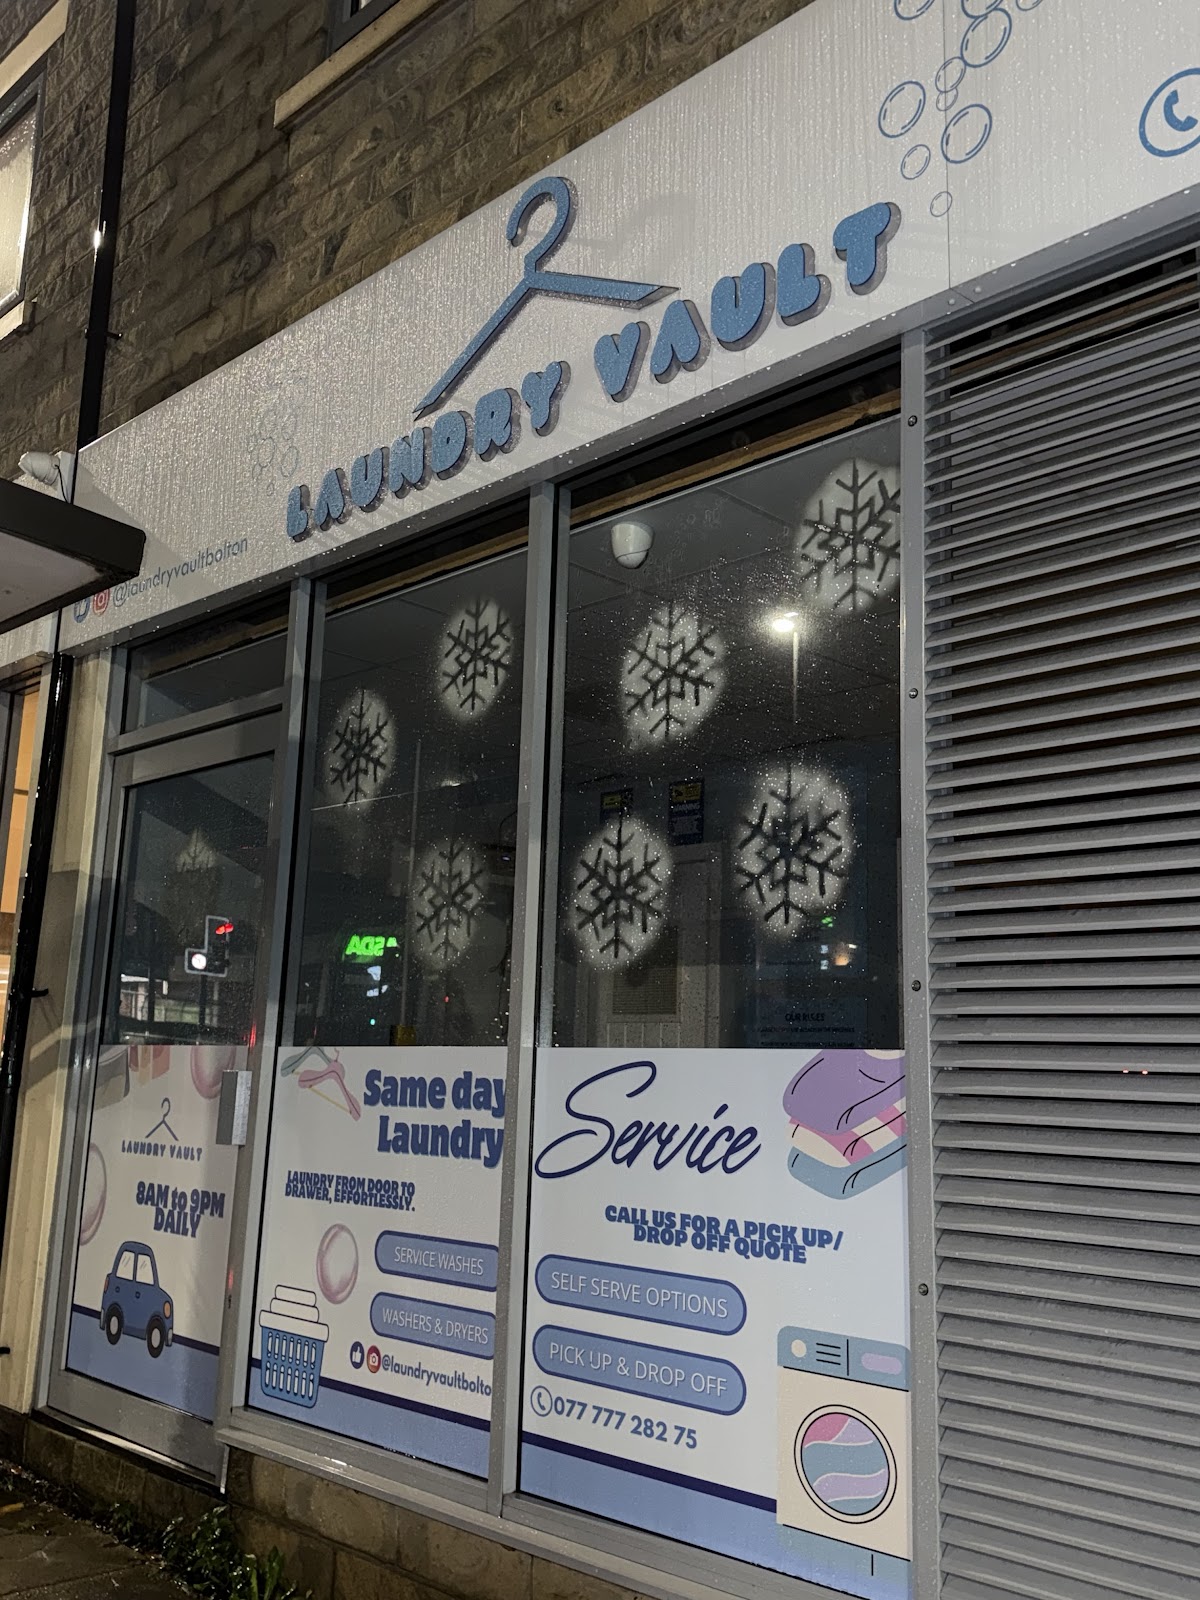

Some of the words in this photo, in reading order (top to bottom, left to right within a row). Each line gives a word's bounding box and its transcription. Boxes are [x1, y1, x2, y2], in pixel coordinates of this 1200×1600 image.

[286, 360, 571, 542] LAUNDRY
[593, 202, 900, 402] VAULT
[112, 538, 249, 608] @laundryvaultbolton
[364, 1069, 446, 1110] Same
[452, 1071, 505, 1118] day
[535, 1061, 761, 1178] Service
[121, 1140, 166, 1157] LAUNDRY
[170, 1144, 203, 1161] VAULT
[378, 1115, 505, 1168] Laundry
[136, 1181, 170, 1209] 8AM
[171, 1187, 188, 1212] to
[190, 1188, 226, 1218] 9PM
[285, 1183, 332, 1204] DRAWER,
[334, 1187, 415, 1211] EFFORTLESSLY.
[287, 1170, 334, 1188] LAUNDRY
[335, 1175, 366, 1193] FROM
[367, 1178, 399, 1196] DOOR
[401, 1181, 415, 1198] TO
[153, 1207, 201, 1238] DAILY
[605, 1205, 649, 1226] CALL
[652, 1210, 677, 1230] US
[680, 1213, 720, 1236] FOR
[724, 1219, 740, 1238] A
[743, 1220, 798, 1245] PICK
[394, 1246, 436, 1268] SERVICE
[438, 1254, 484, 1276] WASHES
[634, 1225, 688, 1248] DROP
[691, 1232, 731, 1253] OFF
[734, 1236, 807, 1264] QUOTE
[551, 1271, 588, 1293] SELF
[590, 1277, 641, 1303] SERVE
[646, 1287, 729, 1318] OPTIONS
[382, 1307, 432, 1333] WASHERS
[434, 1318, 443, 1335] &
[446, 1321, 489, 1344] DRYERS
[382, 1354, 492, 1397] @laundryvaultbolto
[549, 1342, 585, 1366] PICK
[588, 1350, 612, 1371] UP
[616, 1357, 630, 1377] &
[634, 1361, 686, 1387] DROP
[690, 1372, 728, 1397] OFF
[554, 1396, 588, 1421] 077
[591, 1405, 627, 1430] 777
[630, 1415, 668, 1443] 282
[673, 1424, 698, 1449] 75
